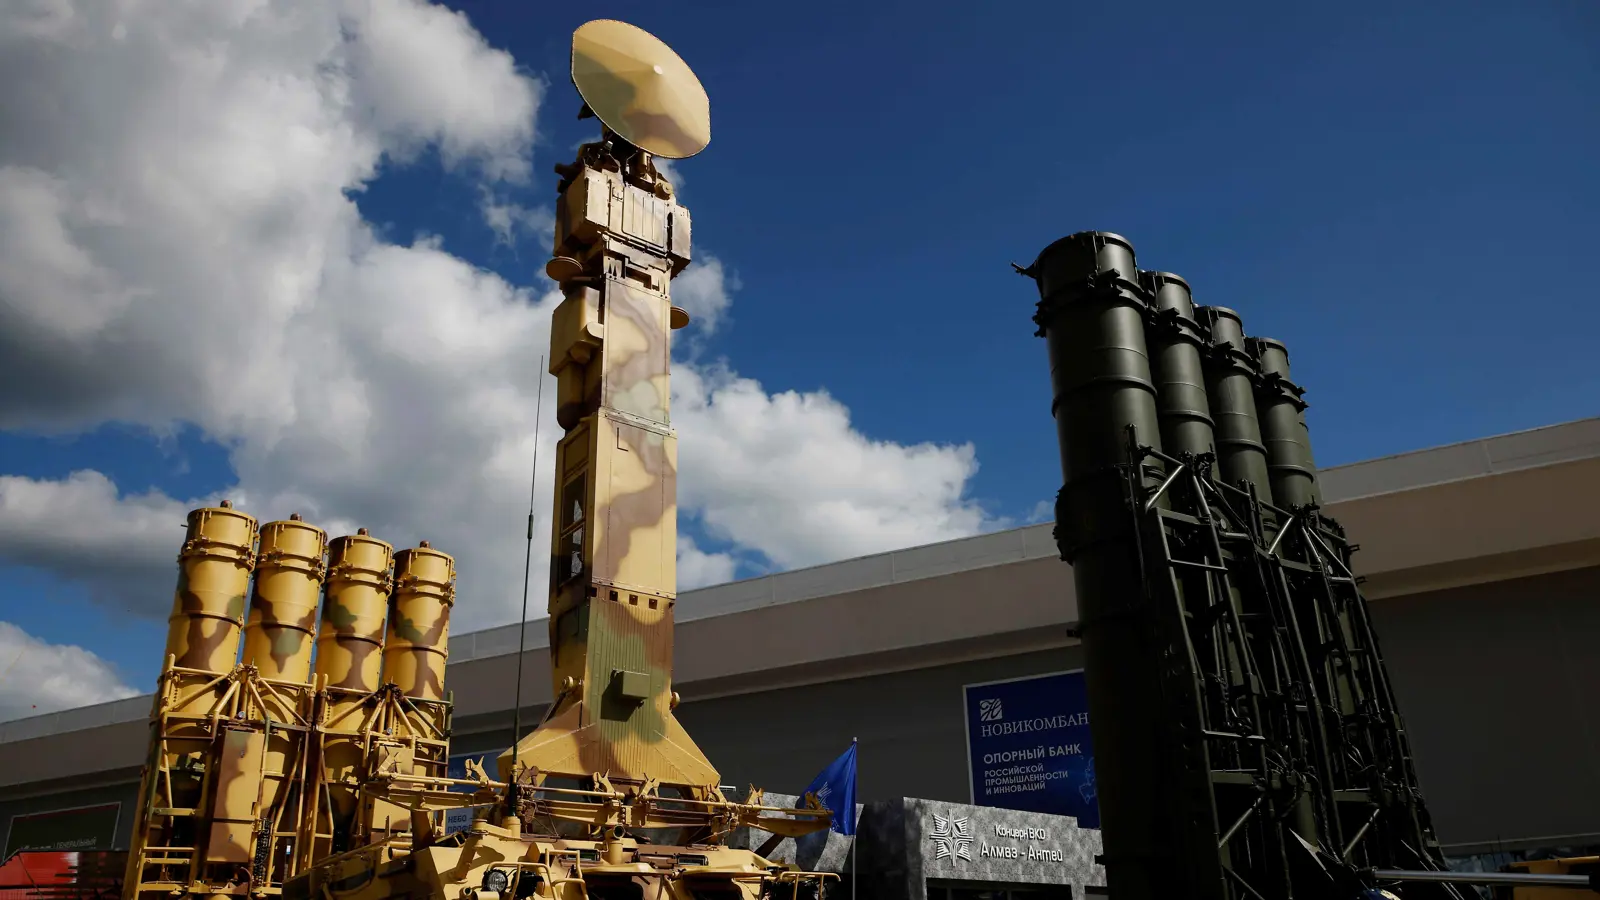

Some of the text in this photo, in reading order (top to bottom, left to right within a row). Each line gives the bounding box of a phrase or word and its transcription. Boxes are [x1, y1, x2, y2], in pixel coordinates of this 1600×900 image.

[981, 712, 1089, 737] НОВИКОМБАН
[984, 743, 1082, 764] ОПОРНЫЙ БАНК
[984, 763, 1044, 778] РОССИЙСКОЙ
[985, 771, 1068, 786] ПРОМЫШЛЕННОСТИ
[986, 781, 1046, 795] И ИННОВАЦИЙ
[981, 841, 1017, 858] Алмаз
